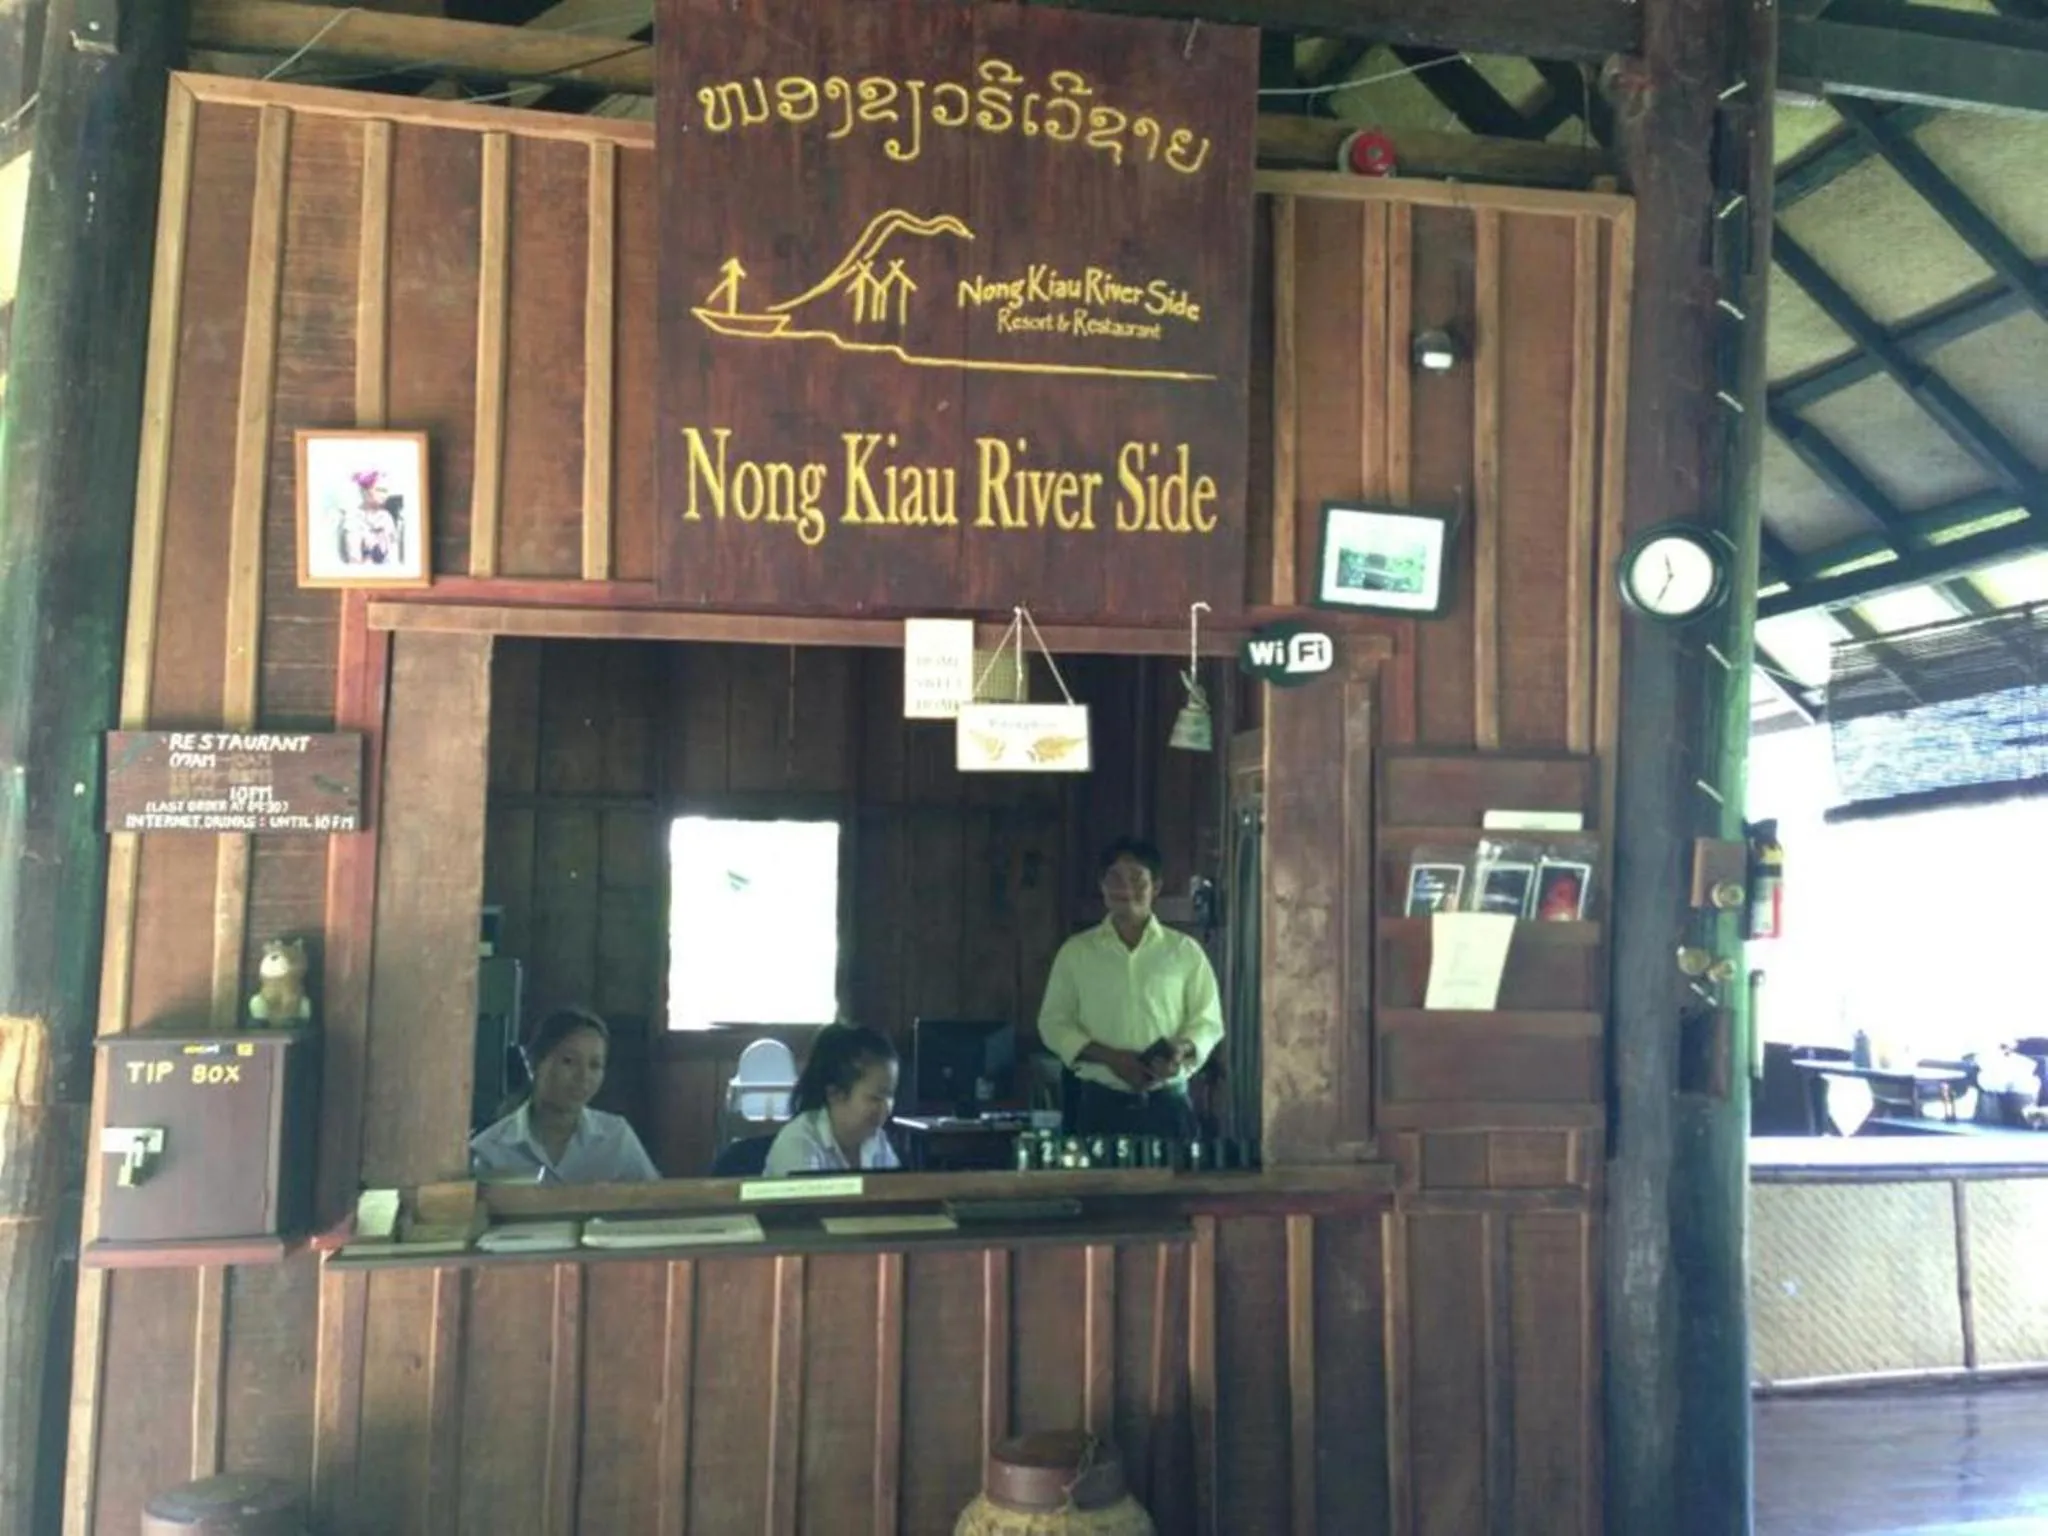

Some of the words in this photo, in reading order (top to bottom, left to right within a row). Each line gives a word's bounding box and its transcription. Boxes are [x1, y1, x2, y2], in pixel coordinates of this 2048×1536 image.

[957, 275, 1025, 310] Nong
[1027, 263, 1082, 301] Kiau
[1084, 266, 1144, 305] River
[1144, 279, 1201, 322] Side
[997, 307, 1054, 334] Resort
[1073, 308, 1162, 341] Restaurant
[682, 427, 827, 545] Nong
[840, 431, 959, 526] Kiau
[974, 436, 1103, 530] River
[1115, 441, 1218, 533] Side
[168, 732, 311, 751] RESTAURANT
[126, 1061, 174, 1084] TIP
[191, 1063, 241, 1084] BOX
